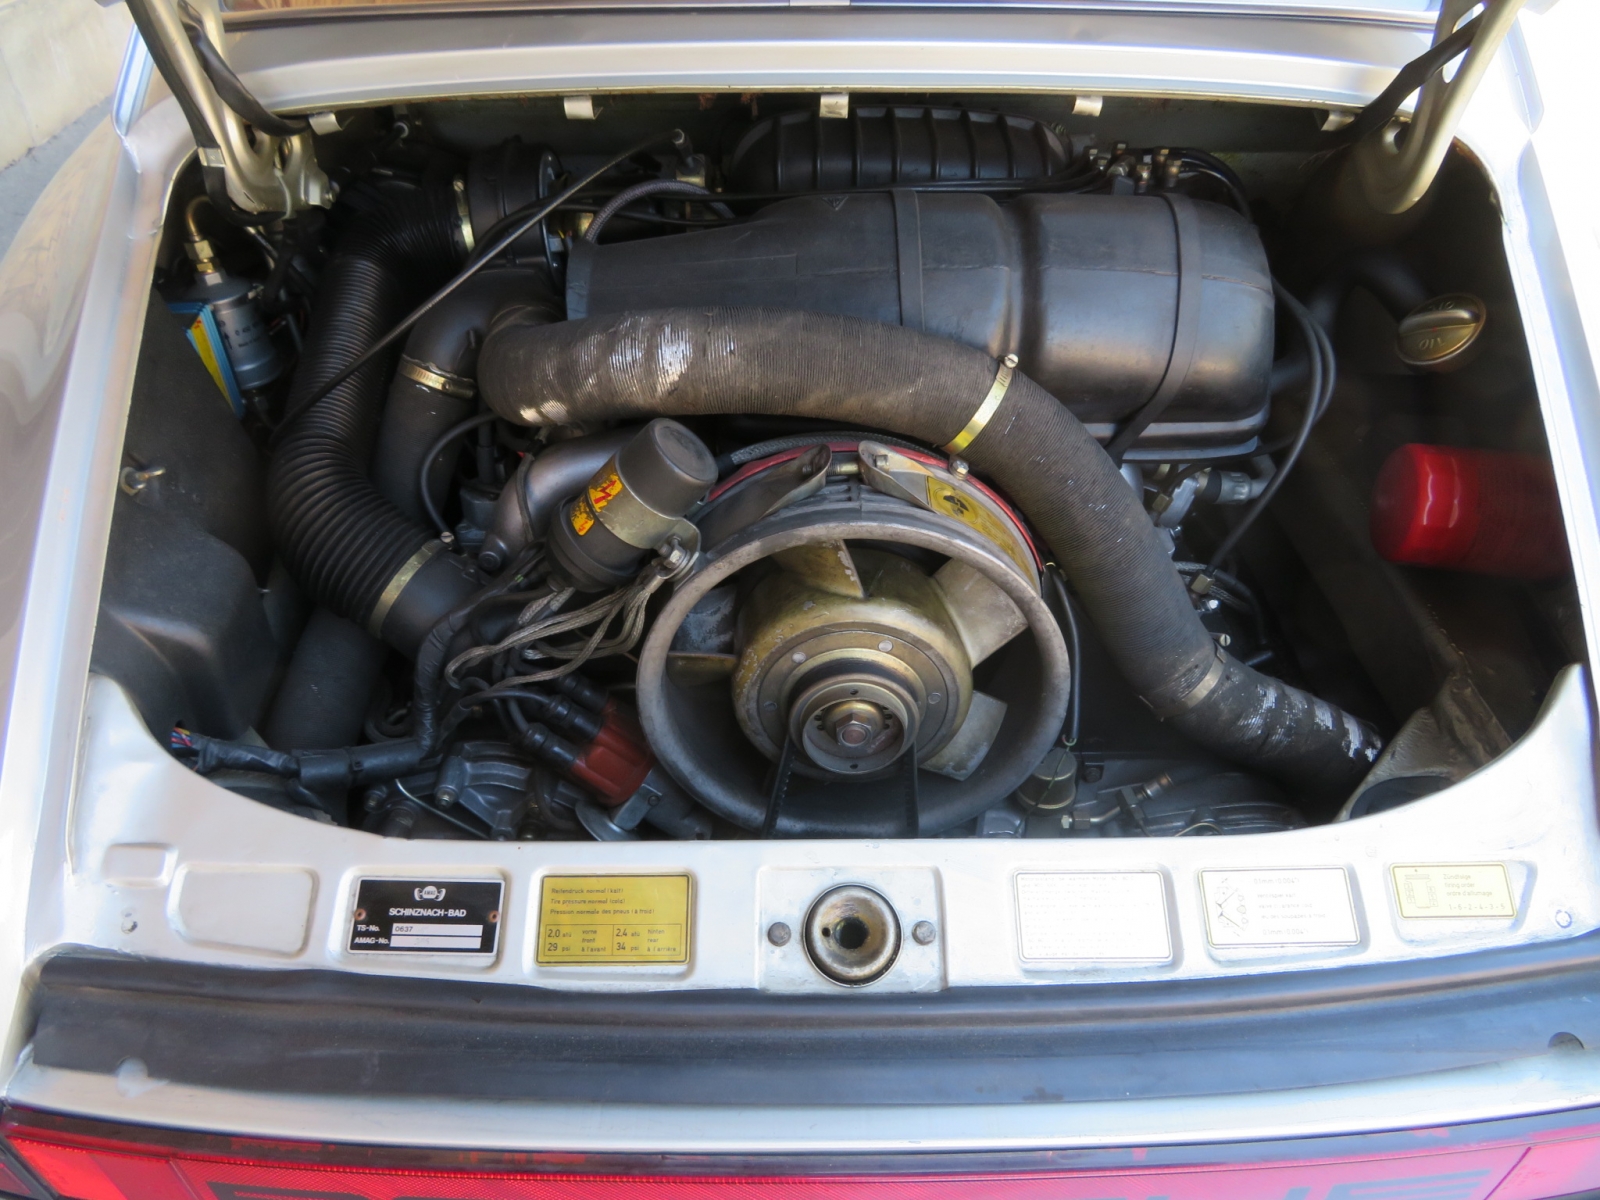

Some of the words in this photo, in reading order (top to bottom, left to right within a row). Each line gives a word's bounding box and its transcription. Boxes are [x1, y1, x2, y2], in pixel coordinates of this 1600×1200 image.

[1419, 337, 1446, 350] OIL
[388, 908, 466, 918] SCHINZNACH-BAD
[548, 942, 558, 952] 29
[616, 942, 626, 952] 34
